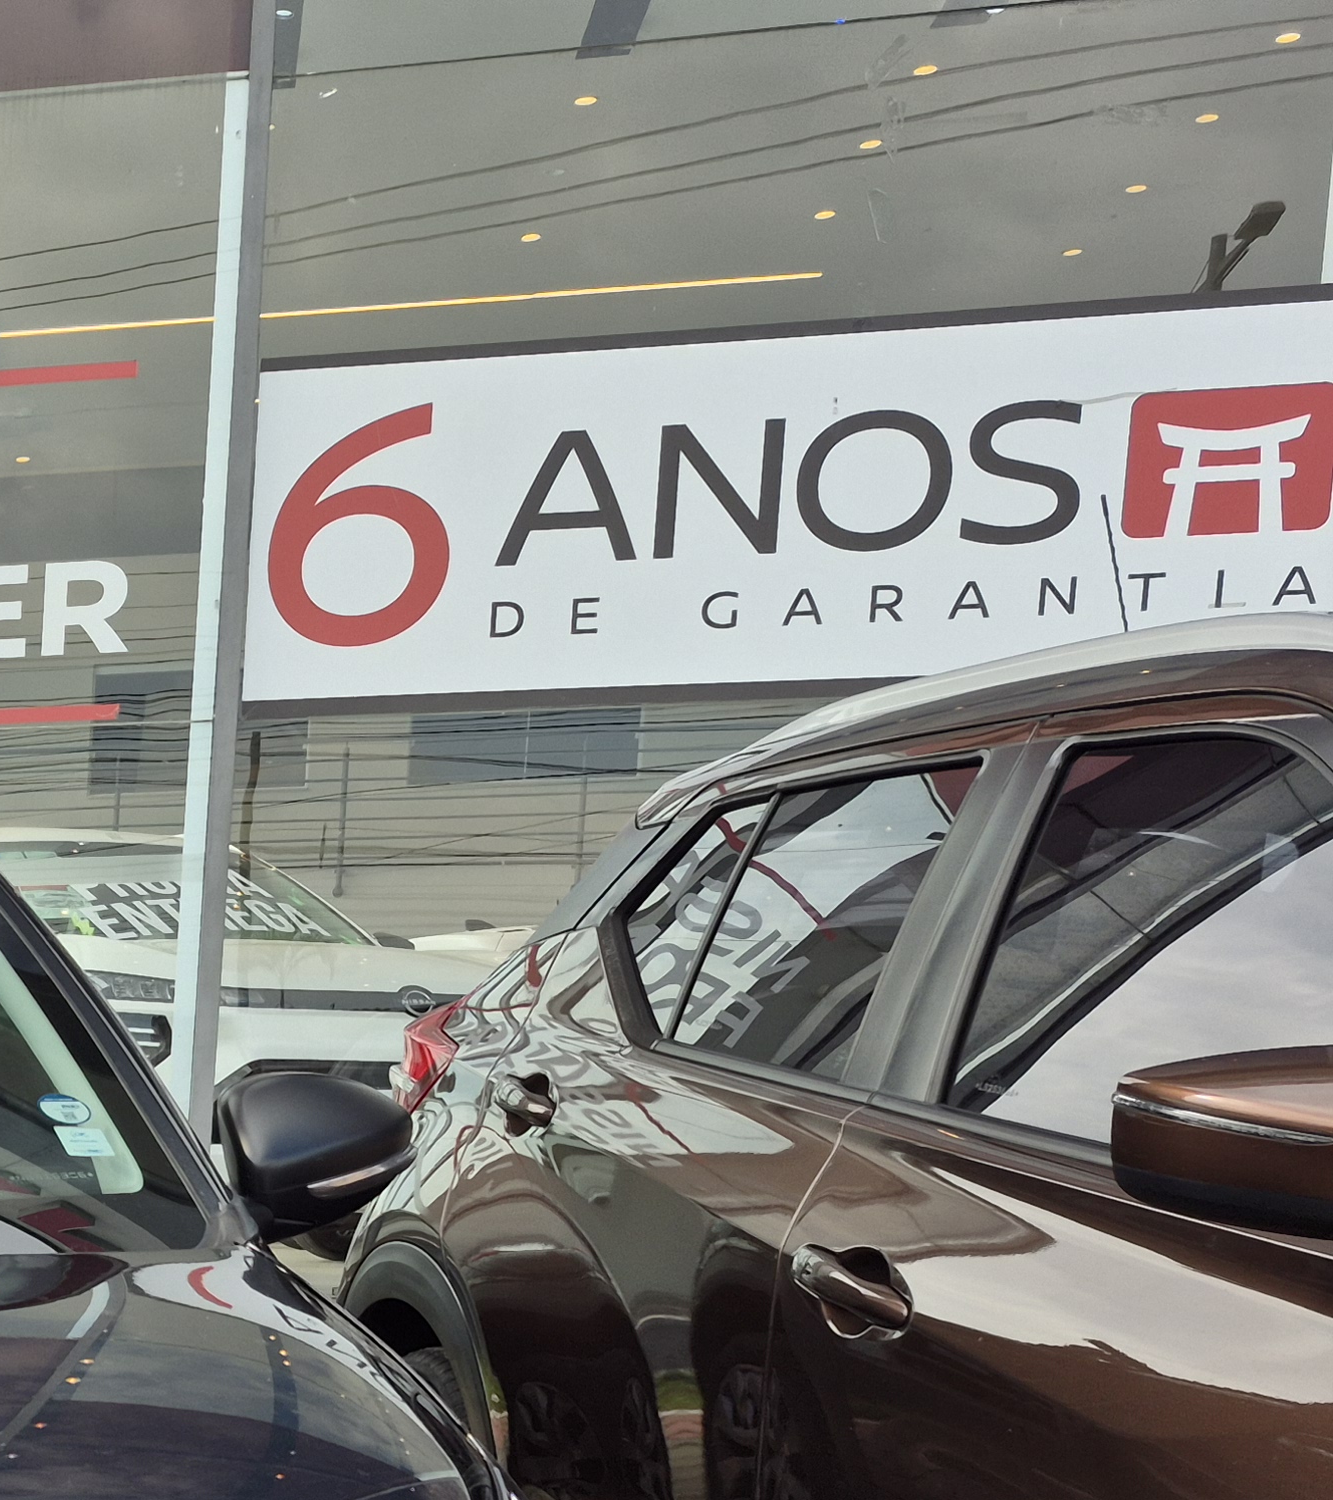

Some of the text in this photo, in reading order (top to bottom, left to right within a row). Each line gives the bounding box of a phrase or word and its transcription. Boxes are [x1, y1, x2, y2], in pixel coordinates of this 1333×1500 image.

[267, 399, 1084, 647] 6 ANOS
[490, 565, 1317, 638] DE GARANTIA
[79, 898, 332, 940] ENTEGA
